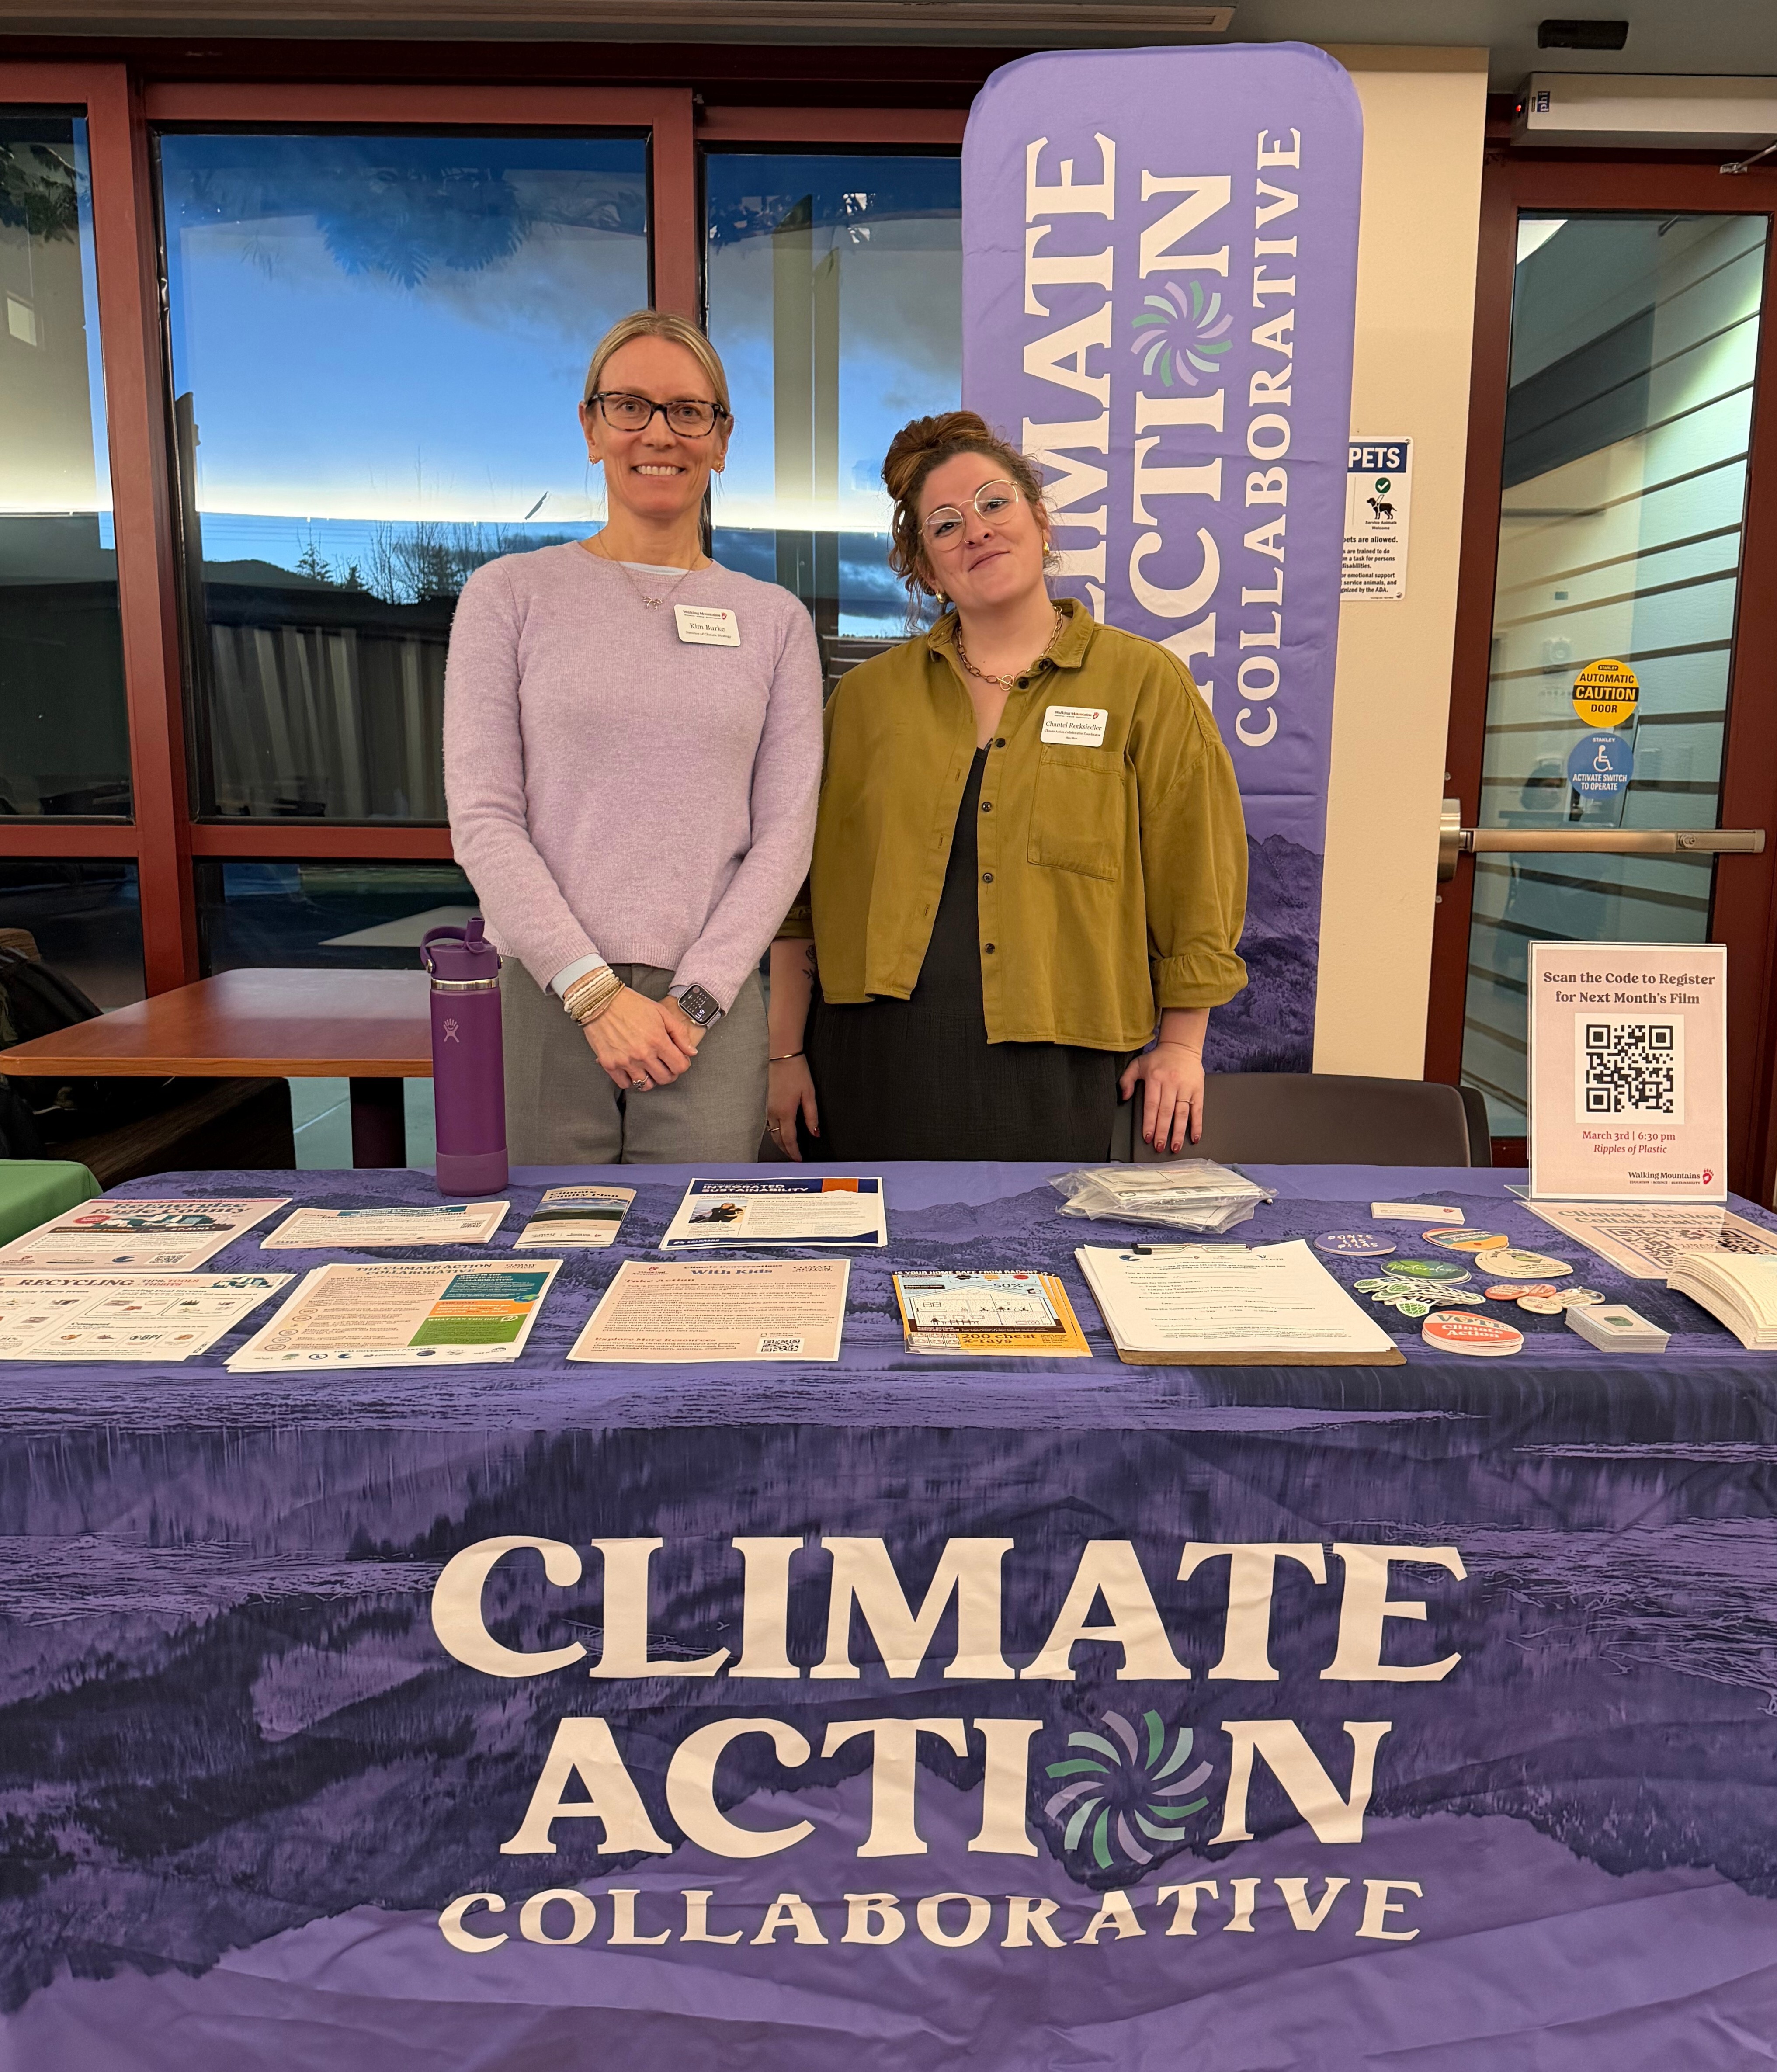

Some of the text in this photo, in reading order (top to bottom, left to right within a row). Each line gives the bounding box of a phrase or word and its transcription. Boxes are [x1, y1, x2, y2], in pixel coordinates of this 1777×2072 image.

[1538, 93, 1549, 111] phi
[1021, 132, 1116, 625] IMATE
[1235, 127, 1301, 747] COLLABORATIVE
[1348, 447, 1400, 469] PETS
[1579, 673, 1634, 684] AUTOMATIC
[1576, 687, 1636, 700] CAUTION
[1590, 704, 1617, 713] DOOR
[1069, 722, 1102, 731] Recksiedler
[1543, 972, 1715, 987] Scan the Code to Register
[1556, 991, 1700, 1004] for Next Month's Film
[1583, 1131, 1676, 1142] March 3rd 6:30 pm
[1593, 1144, 1667, 1155] Ripples of Plastic
[1436, 1314, 1509, 1330] VOTE
[1442, 1324, 1503, 1334] Climate
[1447, 1330, 1500, 1338] Action
[431, 1535, 1468, 1681] CLIMATE
[438, 1877, 1423, 1952] COLLABORATIVE
